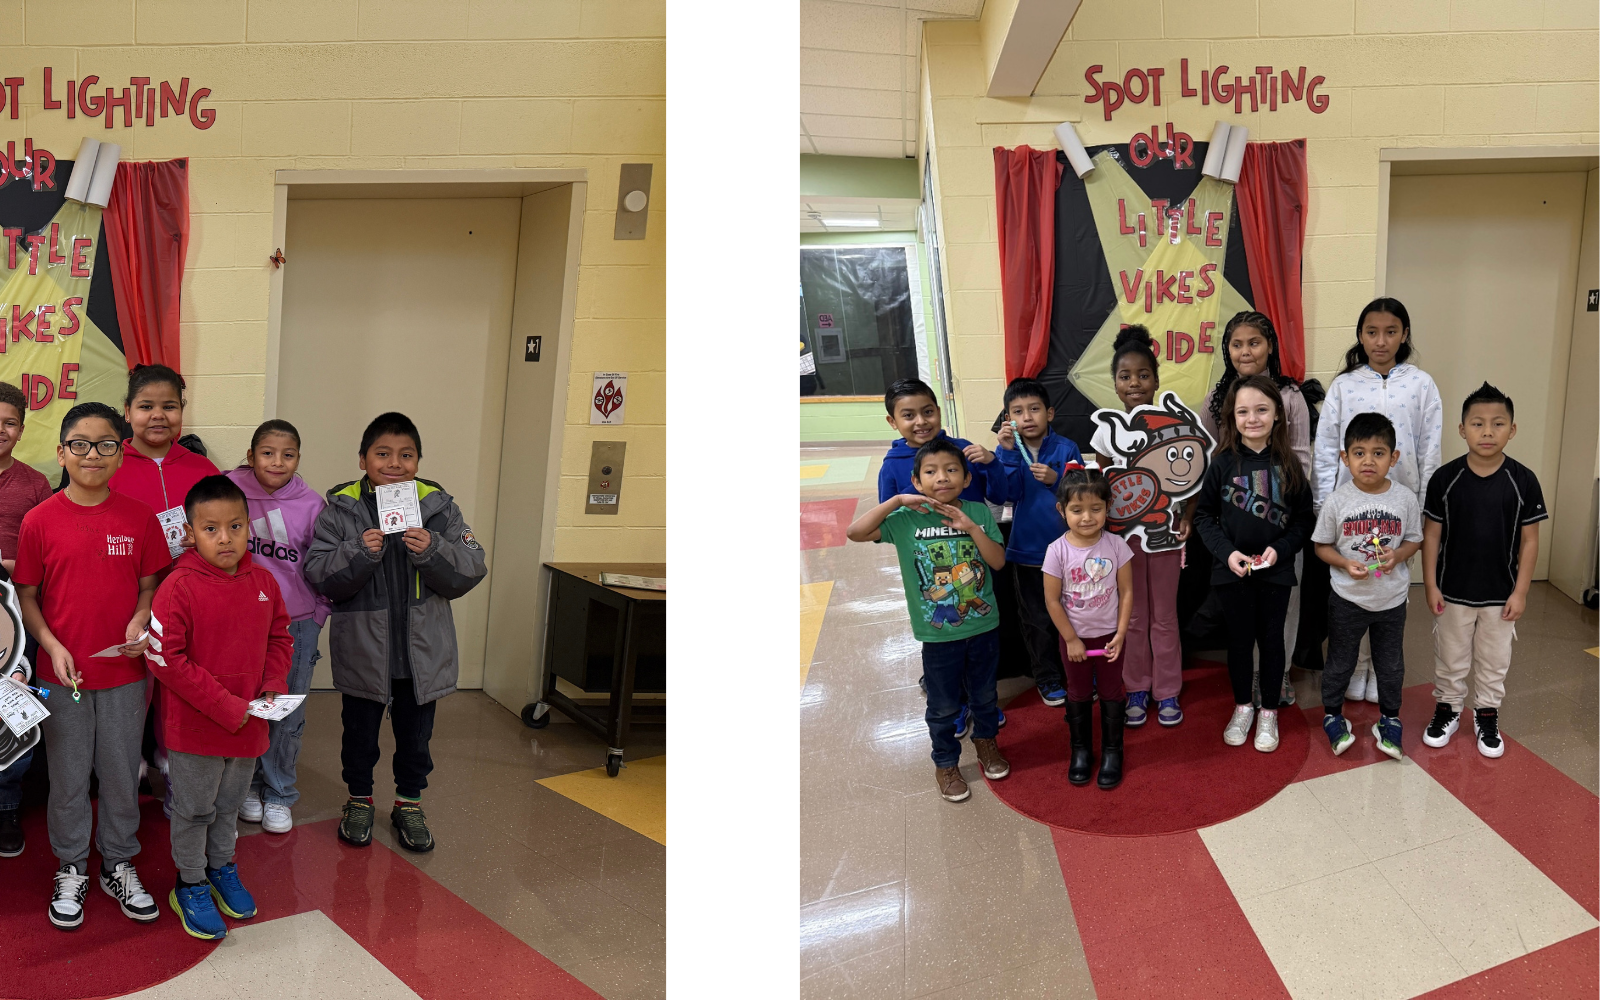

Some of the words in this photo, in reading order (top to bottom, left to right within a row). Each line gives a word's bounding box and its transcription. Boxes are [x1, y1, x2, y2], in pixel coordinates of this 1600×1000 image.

[43, 67, 216, 130] LIGHTING
[1084, 65, 1164, 121] SPOT
[1181, 58, 1330, 114] LIGHTING
[1129, 122, 1194, 169] OUR
[1118, 198, 1223, 247] LITTLE
[1119, 263, 1218, 313] VIKES
[1119, 322, 1215, 363] IDE
[1111, 474, 1142, 505] ITTLE
[1116, 488, 1151, 517] VIKES
[1221, 484, 1290, 530] adidas
[1367, 511, 1381, 519] NYC
[108, 543, 126, 556] Hill
[247, 536, 299, 563] didas
